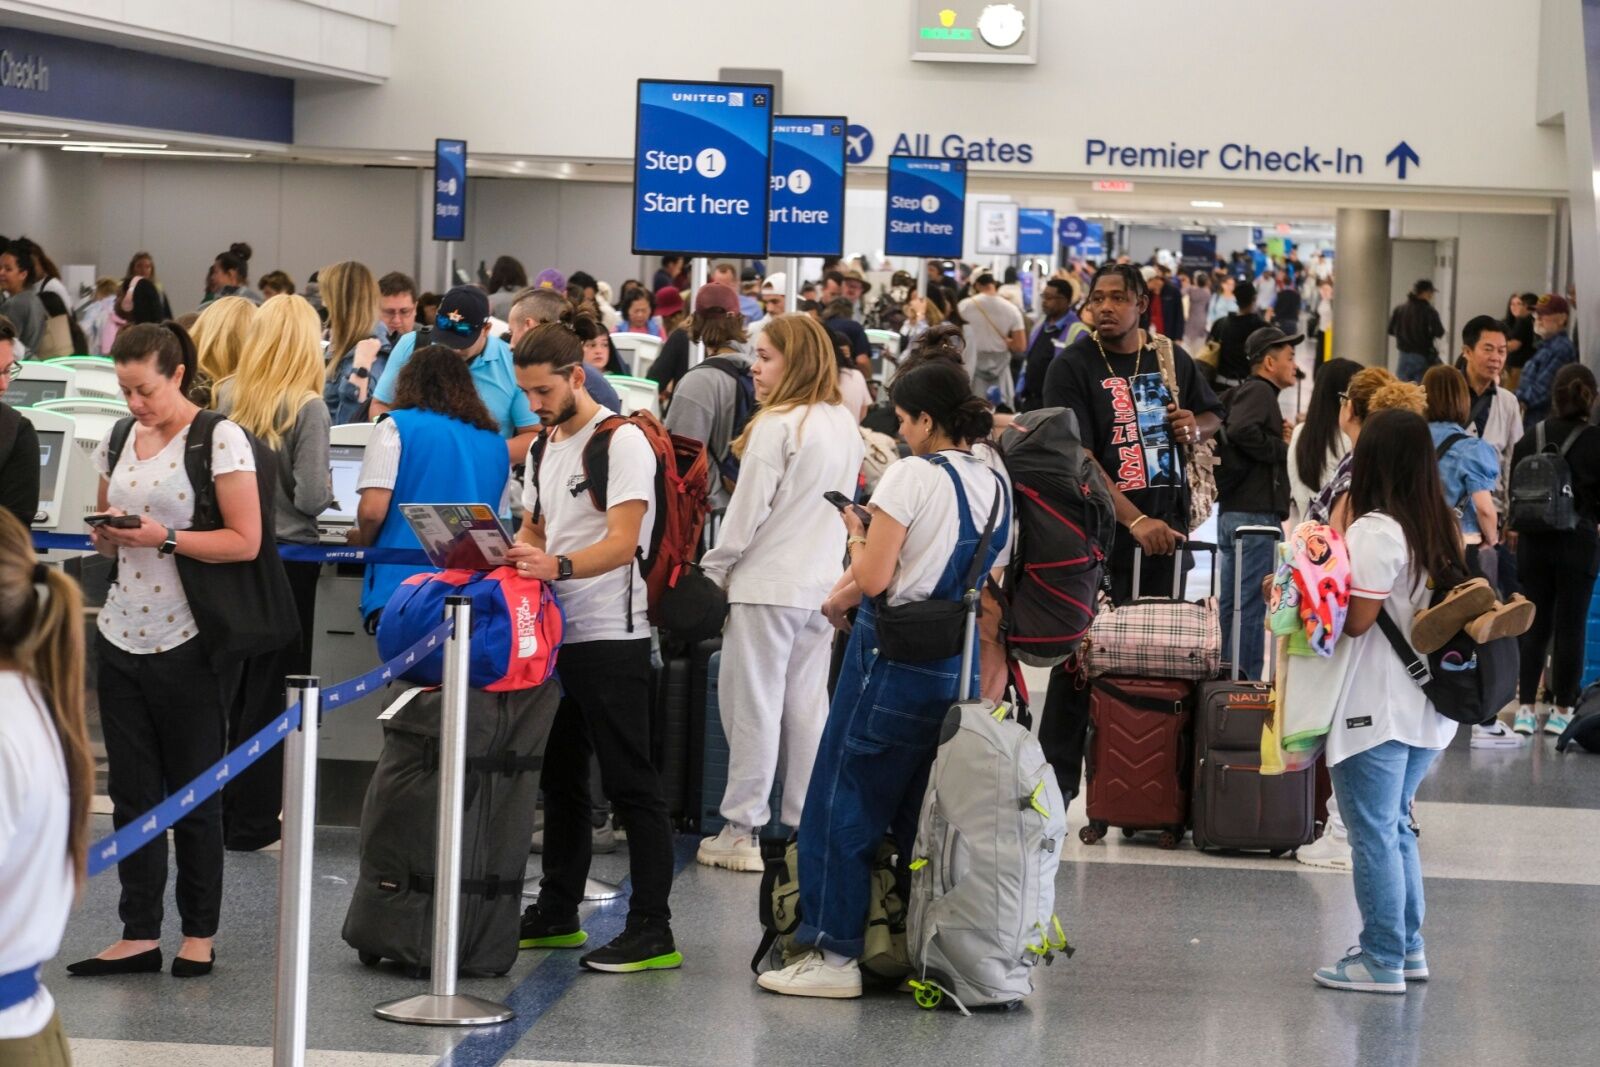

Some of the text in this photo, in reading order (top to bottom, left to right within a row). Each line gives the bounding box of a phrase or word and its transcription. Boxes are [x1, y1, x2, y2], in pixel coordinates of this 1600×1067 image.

[672, 92, 727, 103] UNITED
[891, 132, 1033, 164] All Gates
[1085, 138, 1363, 174] Premier Check-In
[645, 150, 693, 174] Step
[643, 192, 750, 215] Start here
[791, 206, 829, 224] here
[891, 195, 920, 211] Step
[890, 220, 954, 235] Start here
[1101, 376, 1136, 423] HOOD
[515, 607, 524, 637] FACE
[520, 596, 531, 636] NORTH
[529, 612, 537, 636] THE
[1228, 693, 1269, 702] NAUT
